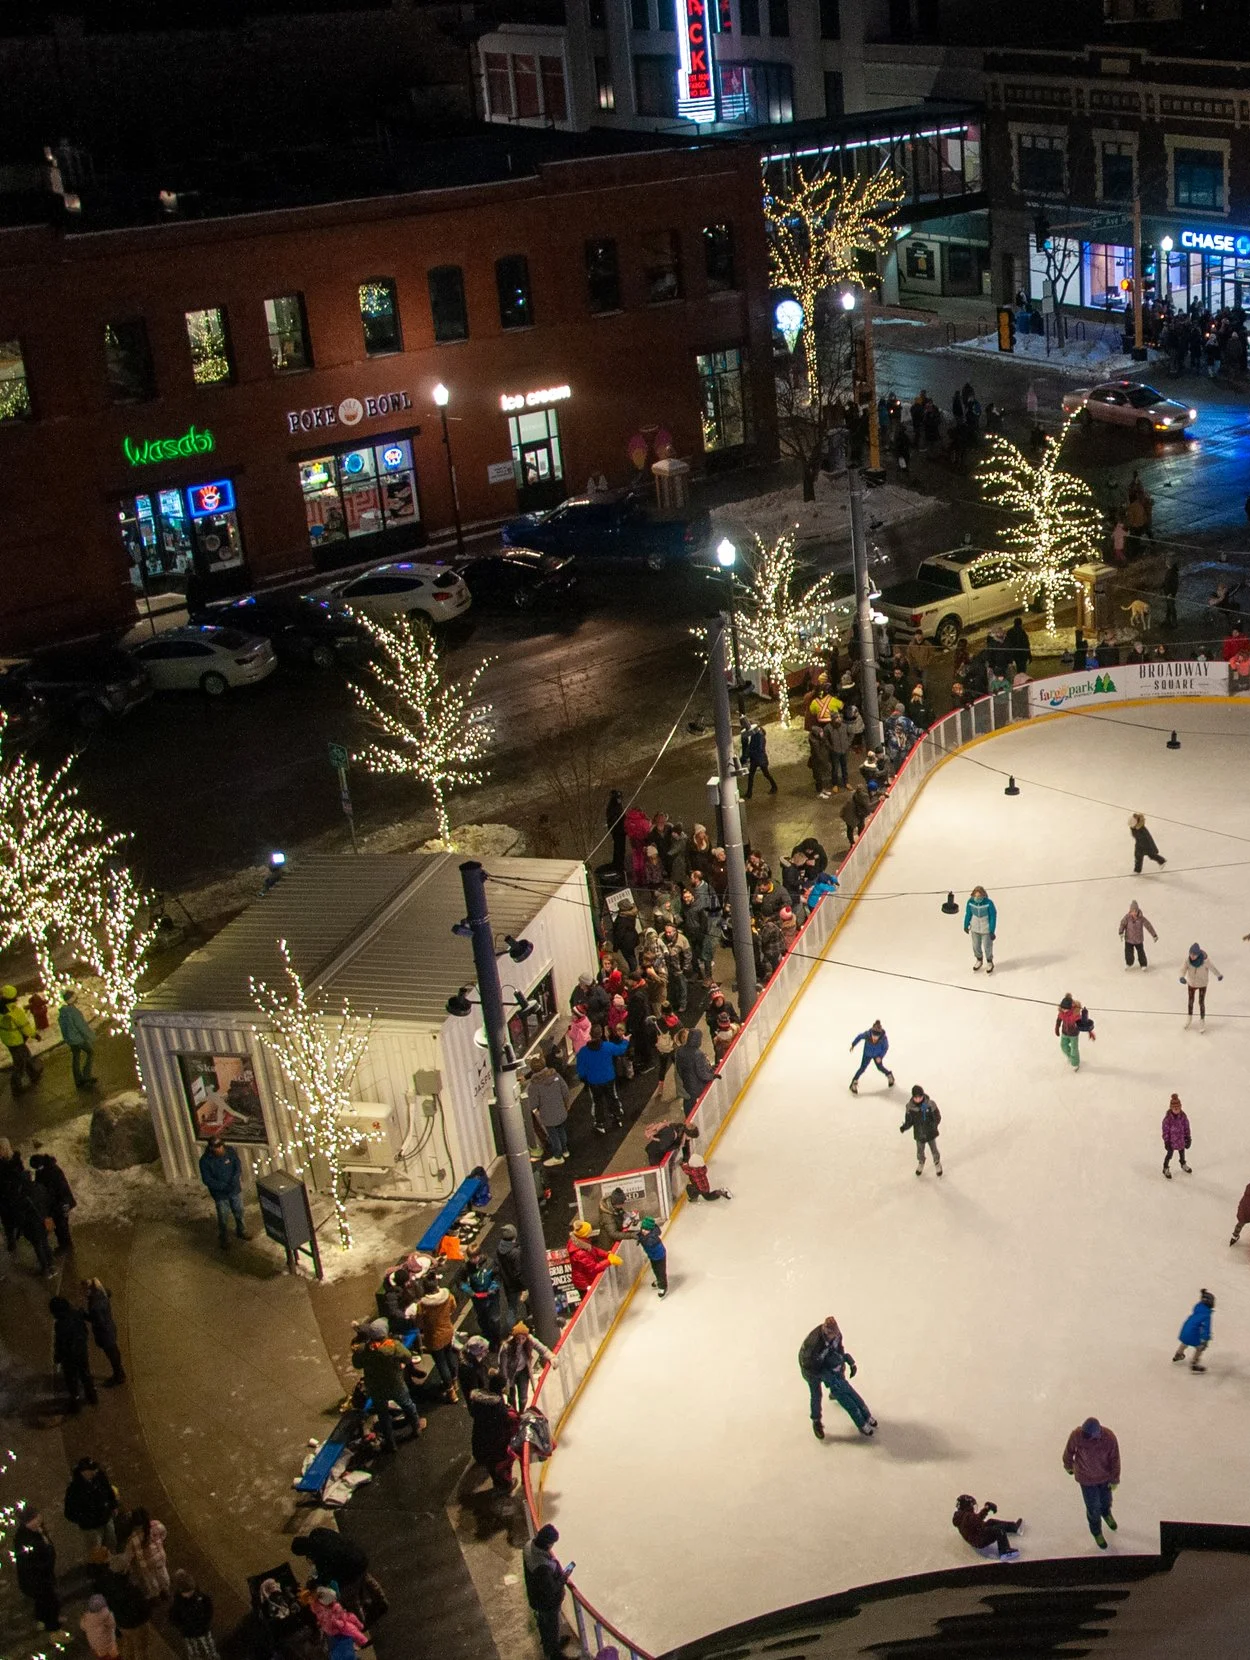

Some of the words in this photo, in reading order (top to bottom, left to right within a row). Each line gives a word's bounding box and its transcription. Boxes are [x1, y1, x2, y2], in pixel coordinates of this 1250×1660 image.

[1181, 231, 1235, 252] CHASE
[288, 405, 337, 433] POKE
[364, 391, 413, 418] BOWL
[124, 424, 213, 467] Wasabi
[1139, 662, 1210, 679] BROADWAY
[1068, 680, 1094, 699] park
[1154, 679, 1195, 690] SQUARE
[474, 1071, 492, 1097] JASPE
